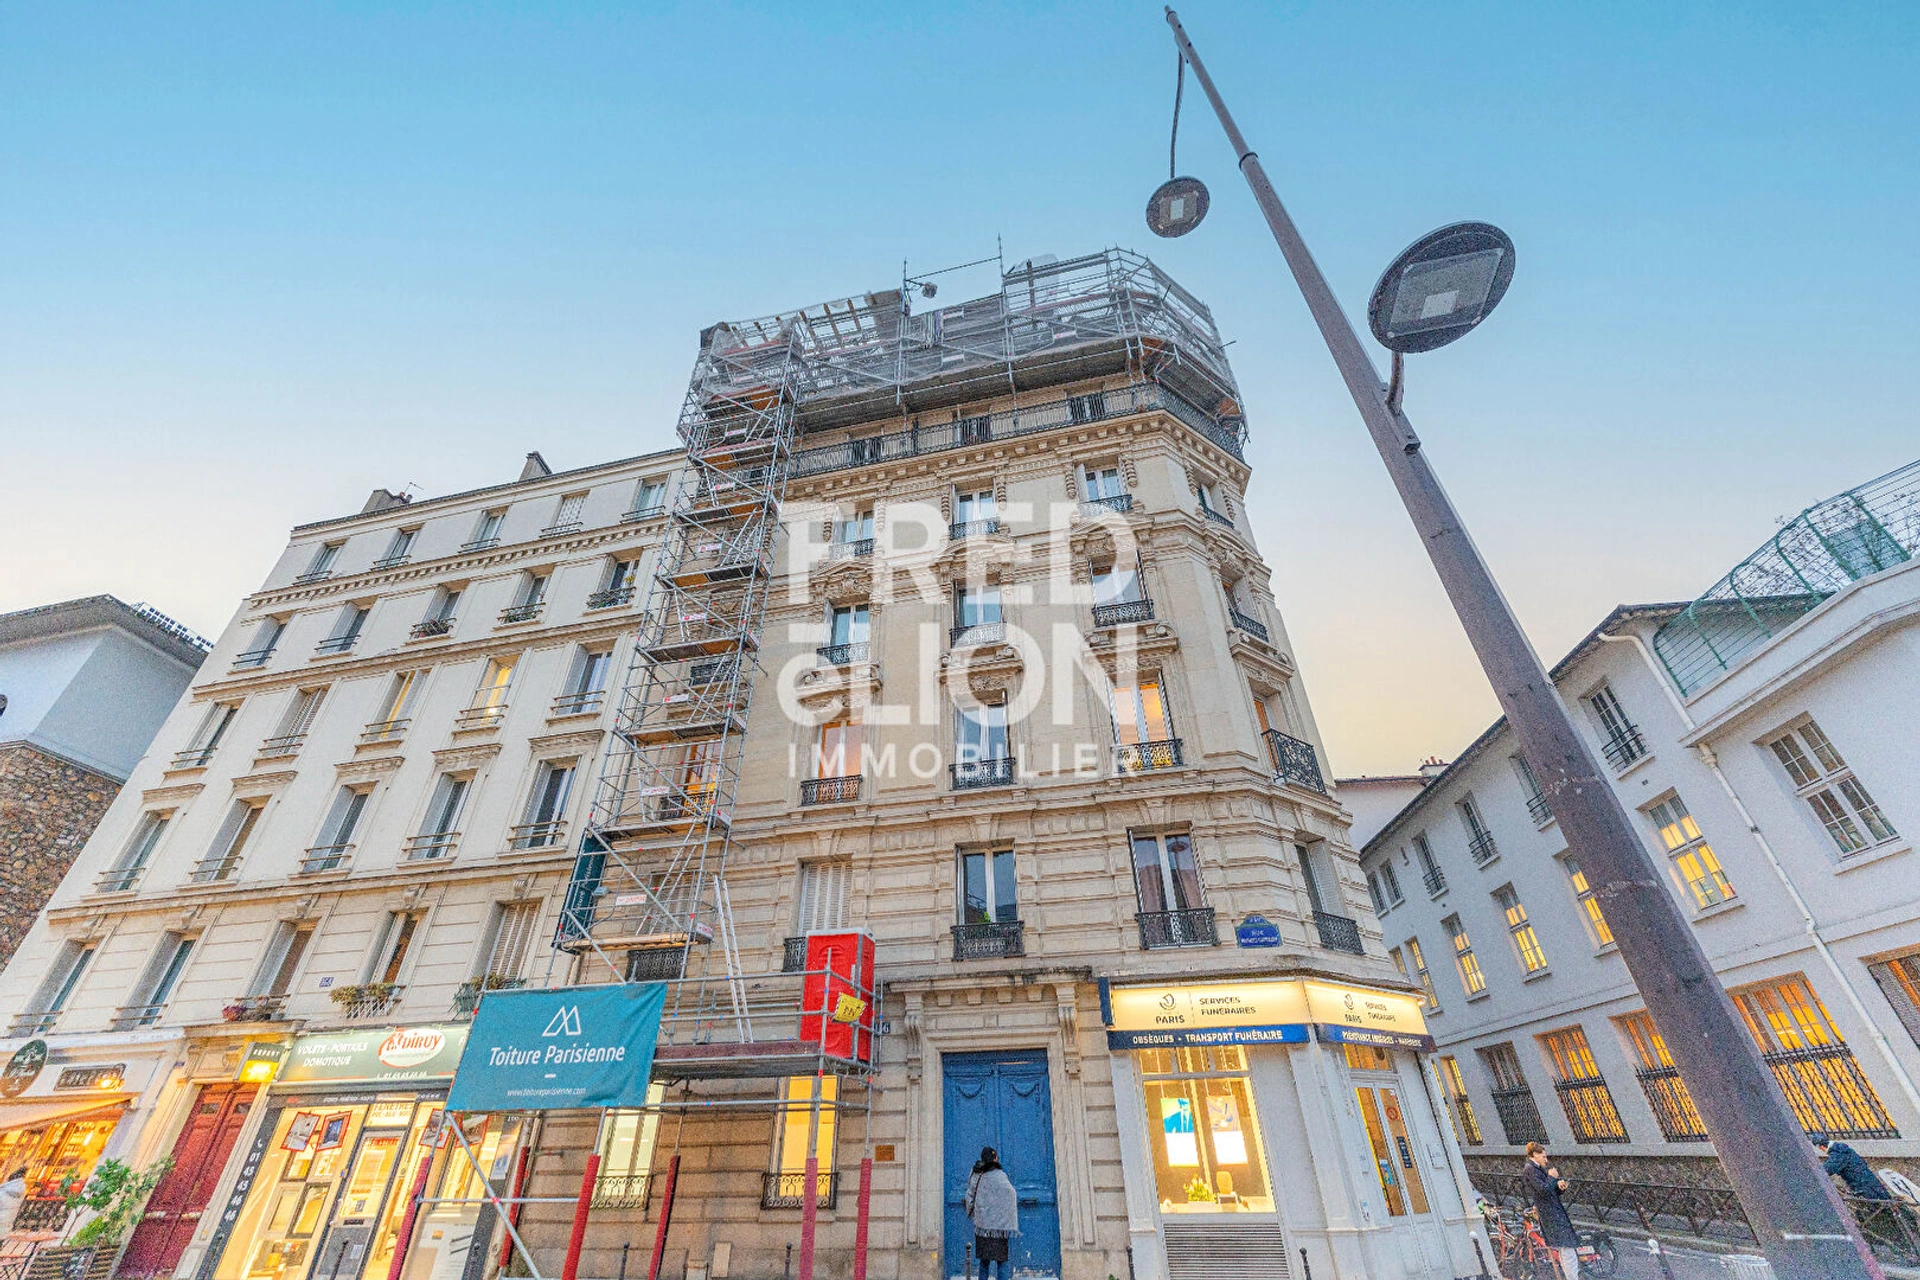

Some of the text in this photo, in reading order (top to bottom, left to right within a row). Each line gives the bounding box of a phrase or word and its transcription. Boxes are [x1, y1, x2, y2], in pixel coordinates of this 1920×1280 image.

[1199, 996, 1241, 1005] SERVICES
[1156, 1014, 1185, 1024] PARIS
[1184, 1031, 1234, 1043] TRANSPORT
[1235, 1029, 1283, 1042] FUNÉRAIRE
[489, 1042, 626, 1066] Toiture Parisienne
[303, 1056, 352, 1067] DOMOTIQUE
[249, 1152, 260, 1162] 01
